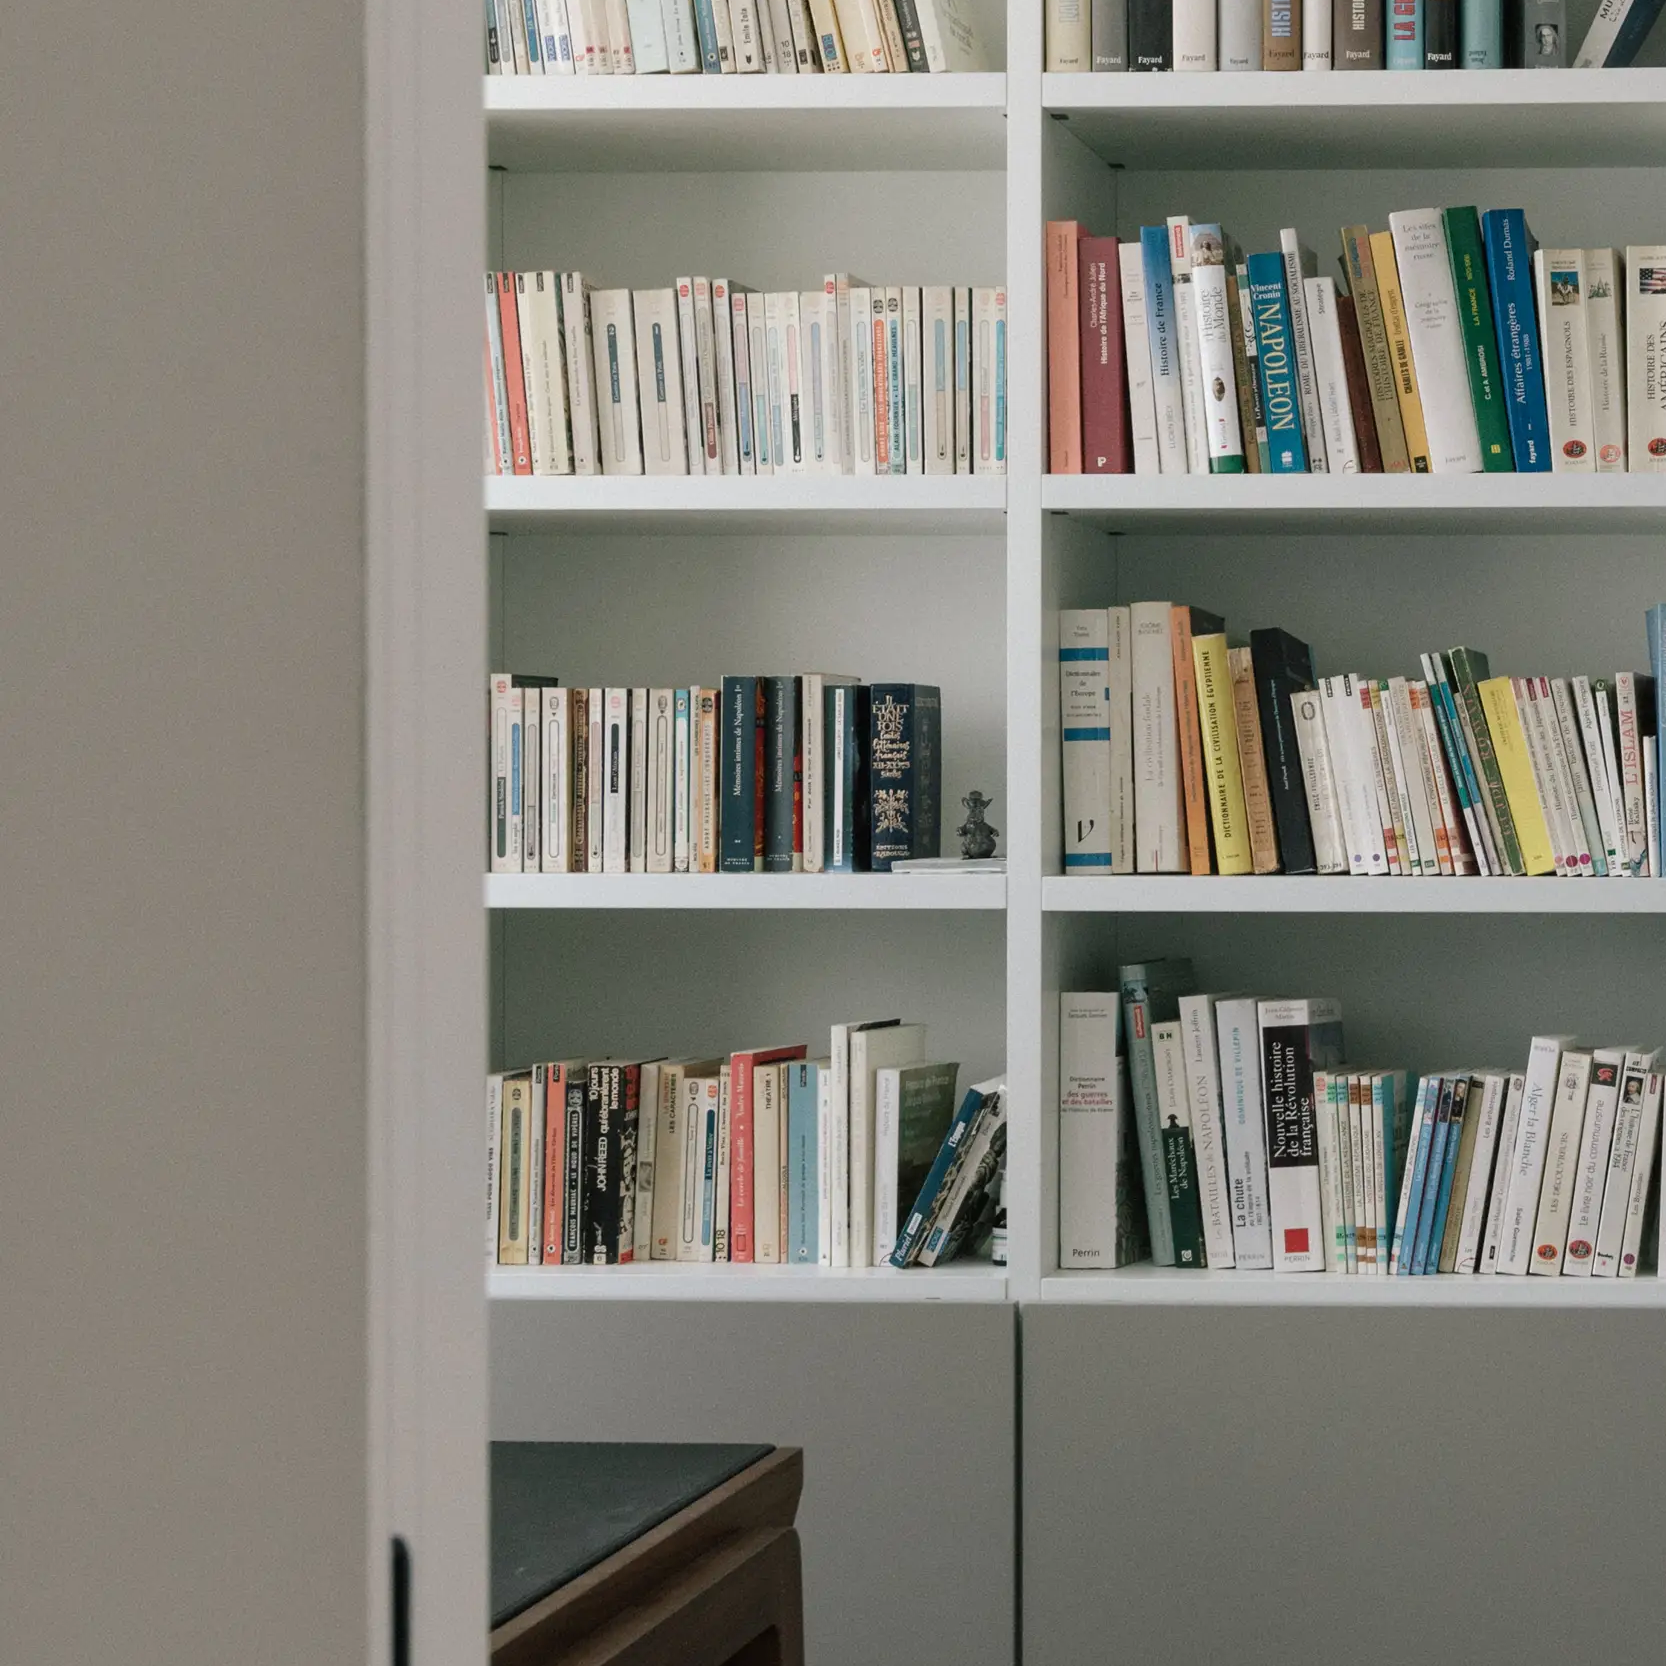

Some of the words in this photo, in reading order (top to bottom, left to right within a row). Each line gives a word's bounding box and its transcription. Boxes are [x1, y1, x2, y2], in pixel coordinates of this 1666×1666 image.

[1394, 22, 1416, 41] LA
[1502, 219, 1514, 249] Dumas
[1504, 251, 1516, 282] Roland
[1153, 283, 1165, 318] France
[1156, 320, 1167, 332] de
[1506, 303, 1525, 359] étrangères
[1646, 334, 1656, 353] DES
[1157, 334, 1170, 376] Histoire
[1257, 304, 1294, 431] NAPOLEON
[1524, 334, 1534, 371] 1981-1988
[1512, 362, 1527, 405] Affaires
[1646, 356, 1656, 400] HISTOIRE
[1201, 649, 1215, 699] ÉGYPTIENNE
[734, 692, 743, 727] Napoléon
[1208, 701, 1223, 753] CIVILISATION
[734, 727, 742, 736] de
[1619, 709, 1639, 786] L'ISLAM
[733, 737, 742, 763] intimes
[1214, 755, 1224, 766] LA
[733, 762, 742, 797] Mémoires
[1216, 770, 1226, 780] DE
[1218, 783, 1233, 840] DICTIONNAIRE
[1269, 1042, 1283, 1092] histoire
[1283, 1047, 1298, 1121] Révolution
[1271, 1096, 1288, 1158] Nouvelle
[1287, 1124, 1298, 1137] la
[1299, 1096, 1313, 1156] française
[1288, 1142, 1300, 1158] de
[1233, 1178, 1245, 1211] chute
[1235, 1214, 1246, 1228] La
